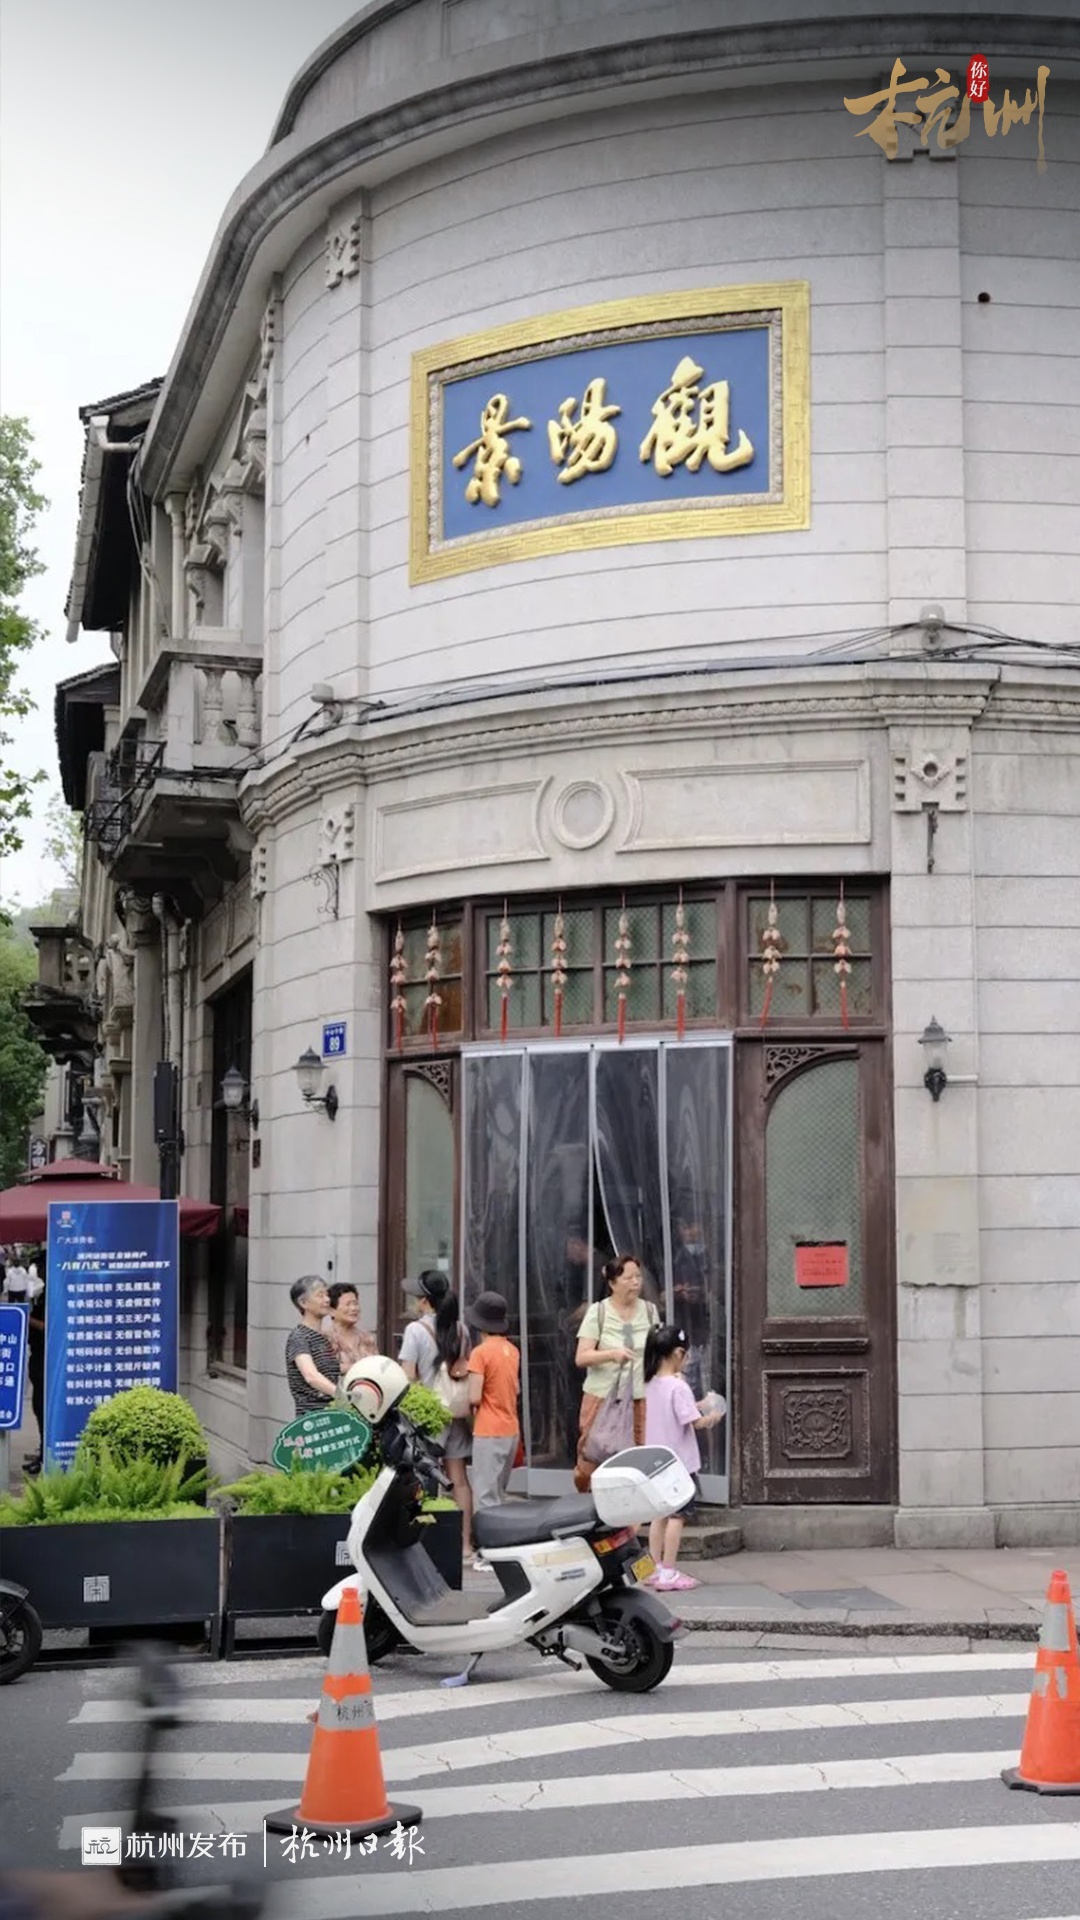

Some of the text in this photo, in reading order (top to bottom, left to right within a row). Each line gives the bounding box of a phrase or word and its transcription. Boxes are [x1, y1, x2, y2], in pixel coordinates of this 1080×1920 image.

[115, 1314, 160, 1324] 无三无产品
